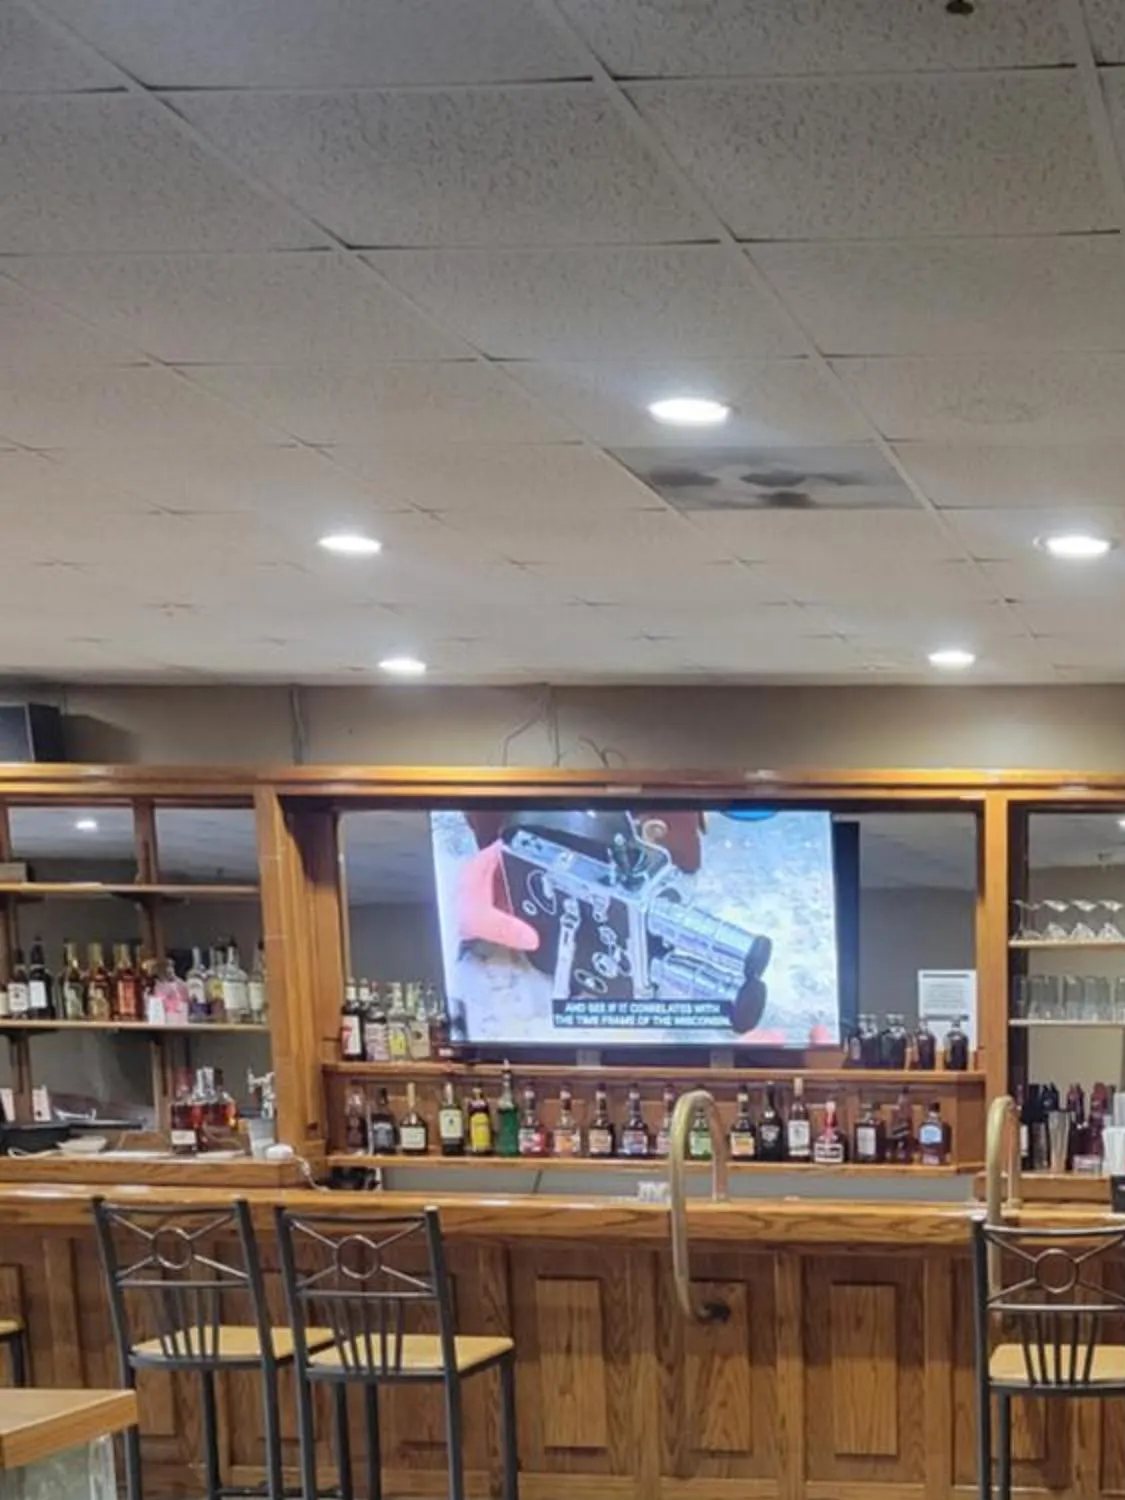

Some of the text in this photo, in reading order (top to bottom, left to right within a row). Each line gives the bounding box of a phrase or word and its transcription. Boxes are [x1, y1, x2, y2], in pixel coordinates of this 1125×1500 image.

[565, 1002, 586, 1014] AND
[694, 1003, 721, 1014] WITH
[555, 1014, 573, 1025] THE
[575, 1014, 599, 1025] TIME
[601, 1014, 635, 1025] FRAME
[637, 1014, 649, 1025] OF
[652, 1015, 672, 1025] THE
